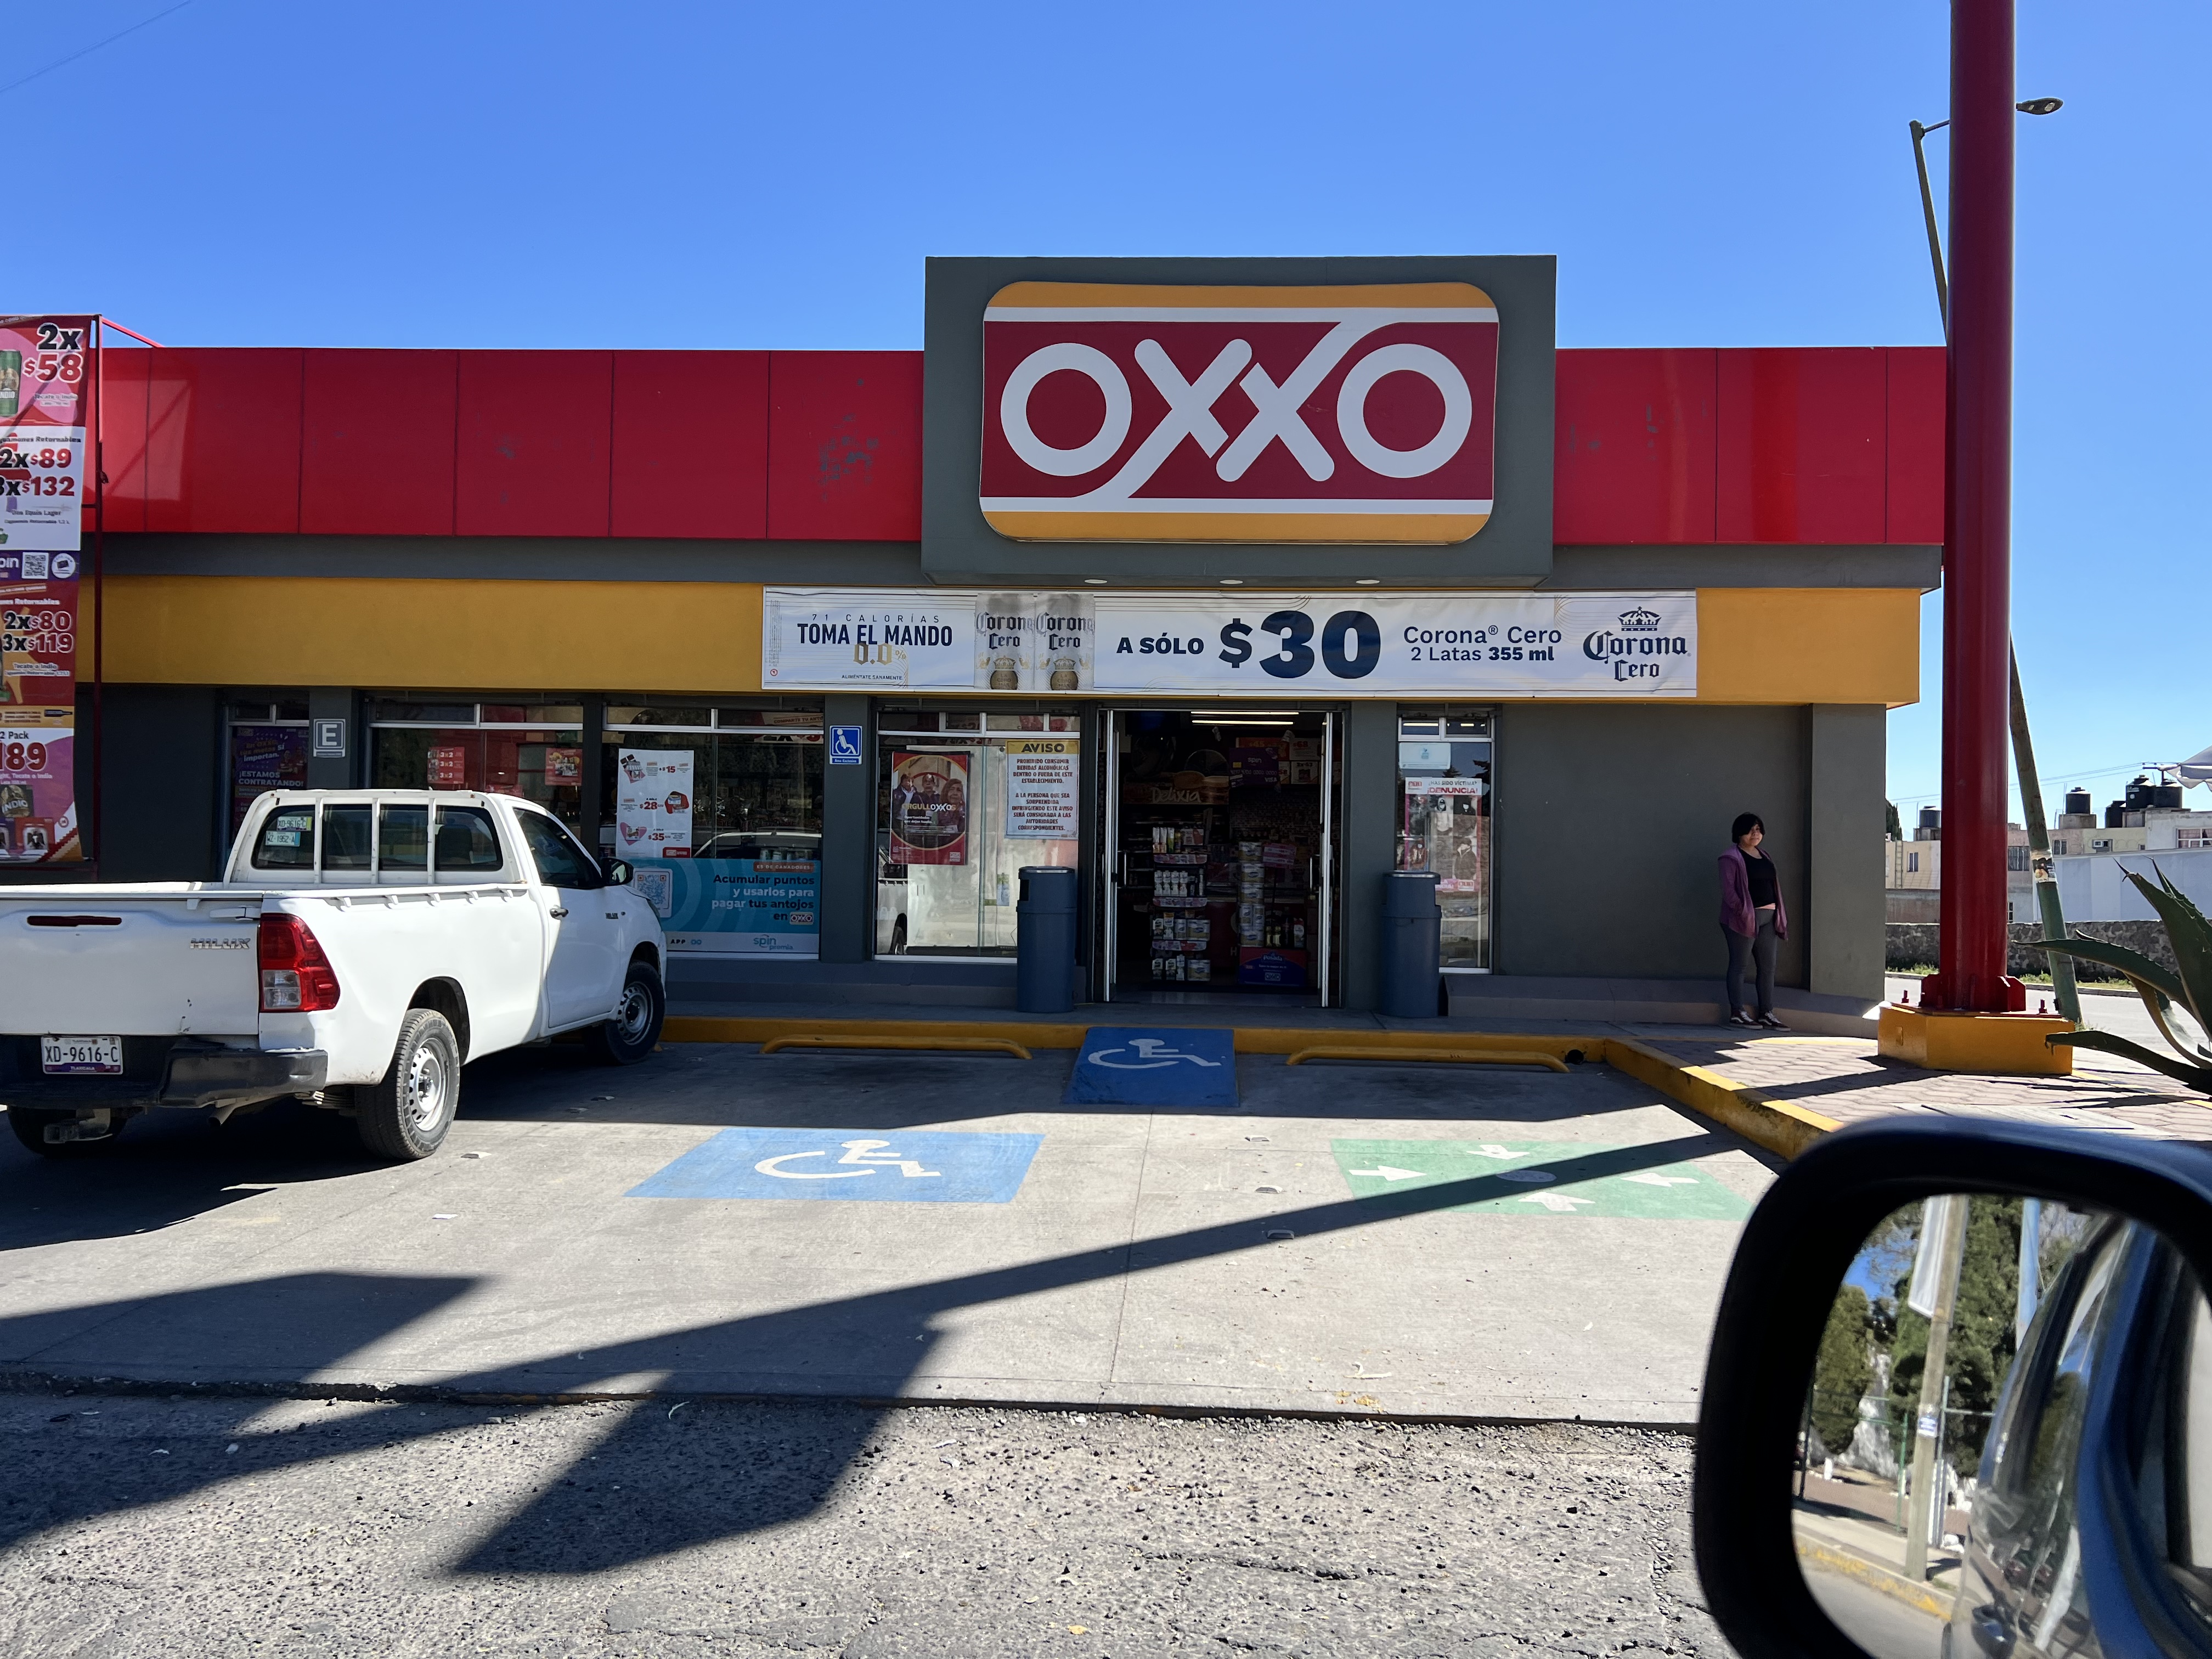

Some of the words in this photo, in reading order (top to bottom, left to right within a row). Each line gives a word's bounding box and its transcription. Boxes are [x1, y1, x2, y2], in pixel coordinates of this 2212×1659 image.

[37, 323, 82, 351] 2x
[23, 352, 83, 383] $58
[1000, 325, 1472, 495] OXXO
[846, 613, 940, 623] CALORÍAS
[977, 612, 1035, 636] Corona
[1036, 612, 1094, 637] Corona
[797, 623, 850, 645] TOMA
[857, 624, 878, 645] EL
[885, 625, 953, 646] MANDO
[989, 633, 1020, 650] Cero
[1048, 634, 1081, 651] Cero
[1507, 627, 1562, 644] Cero
[1116, 637, 1133, 653] A
[1139, 633, 1204, 654] SÓLO
[1218, 610, 1381, 679] $30
[1411, 647, 1421, 661] 2
[1430, 647, 1481, 661] Latas
[1488, 646, 1523, 661] 355
[1529, 646, 1554, 661] ml
[1614, 659, 1660, 682] Cero
[322, 724, 337, 746] E
[1021, 743, 1065, 752] AVISO
[238, 778, 304, 787] CONTRATANDO!
[713, 874, 770, 884] Acumular
[774, 876, 815, 886] puntos
[733, 888, 740, 898] y
[743, 887, 785, 896] usarlos
[789, 889, 814, 898] para
[712, 900, 746, 910] pagar
[749, 899, 768, 908] tus
[771, 899, 815, 911] antojos
[791, 913, 813, 923] OXXO
[190, 938, 251, 949] HILUX
[753, 935, 776, 946] spin
[45, 1046, 118, 1062] XD-9616-C
